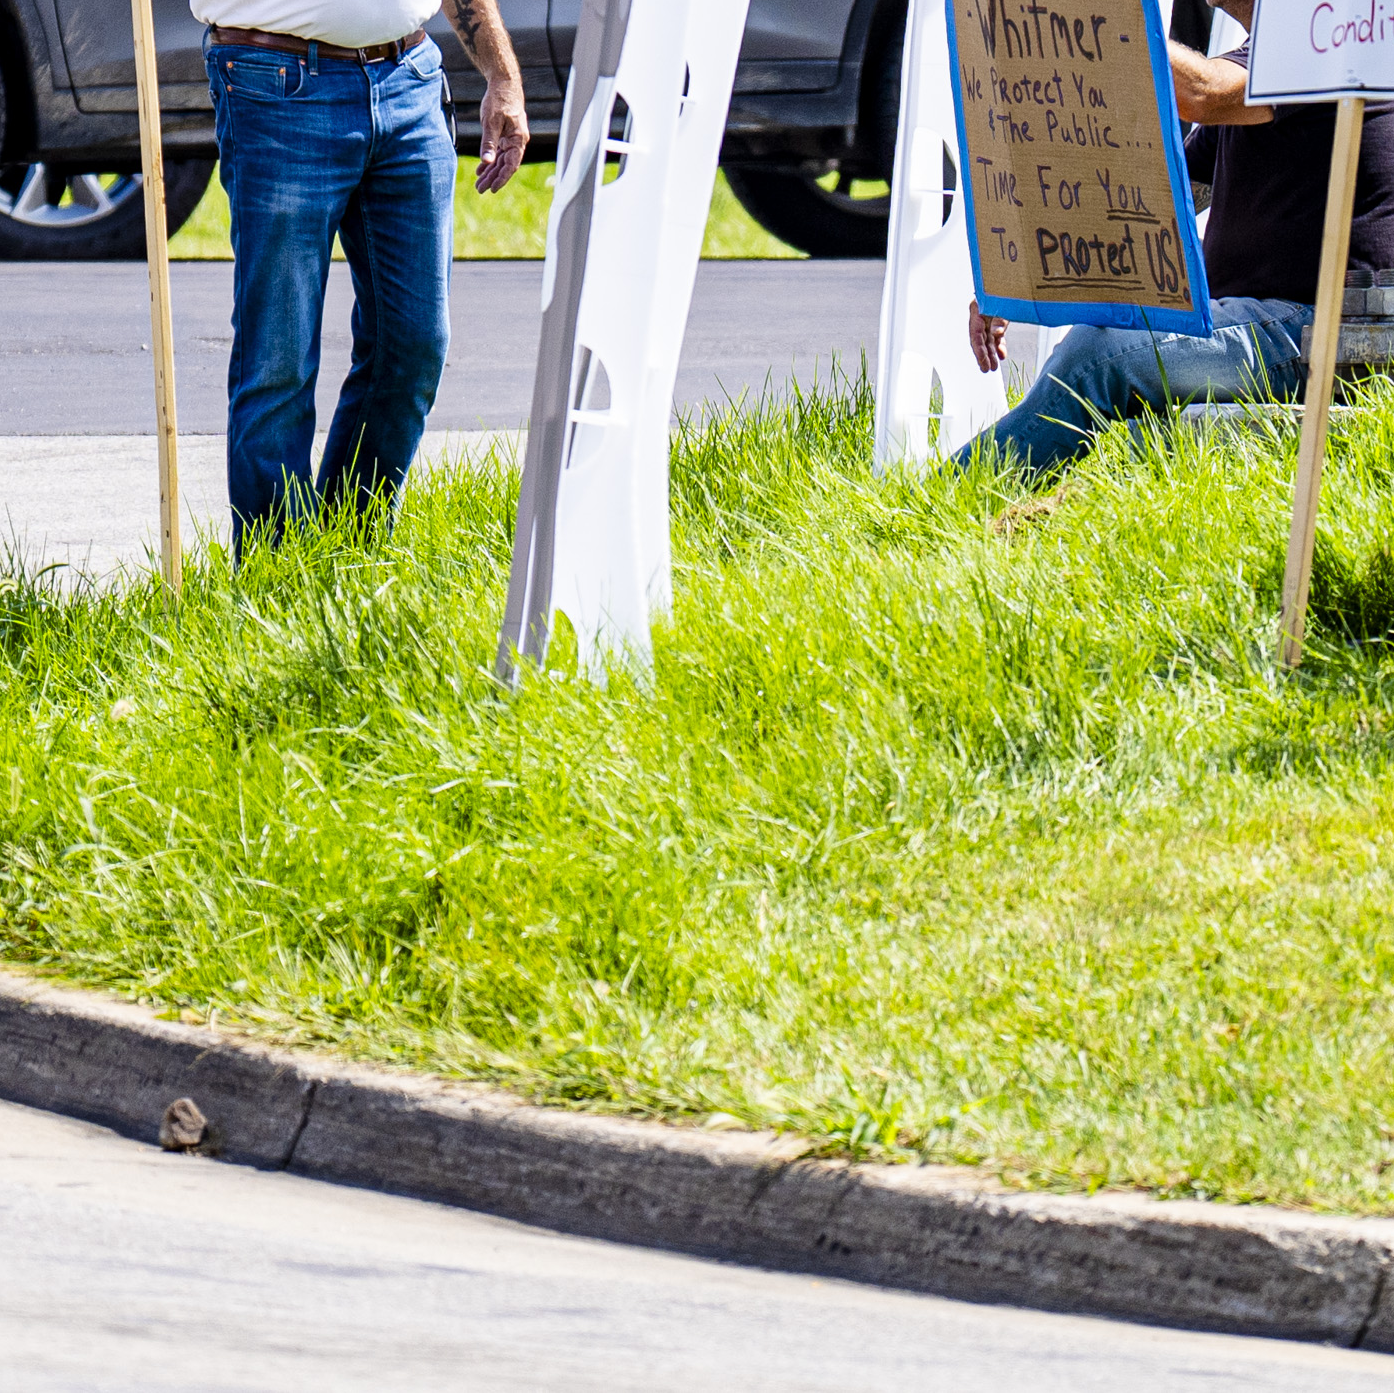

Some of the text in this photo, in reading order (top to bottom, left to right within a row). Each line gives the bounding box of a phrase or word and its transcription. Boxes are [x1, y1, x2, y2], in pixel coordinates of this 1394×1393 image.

[962, 64, 983, 100] We
[1072, 70, 1107, 110] You
[1038, 165, 1082, 211] For
[1096, 168, 1149, 216] You
[990, 227, 1018, 263] To
